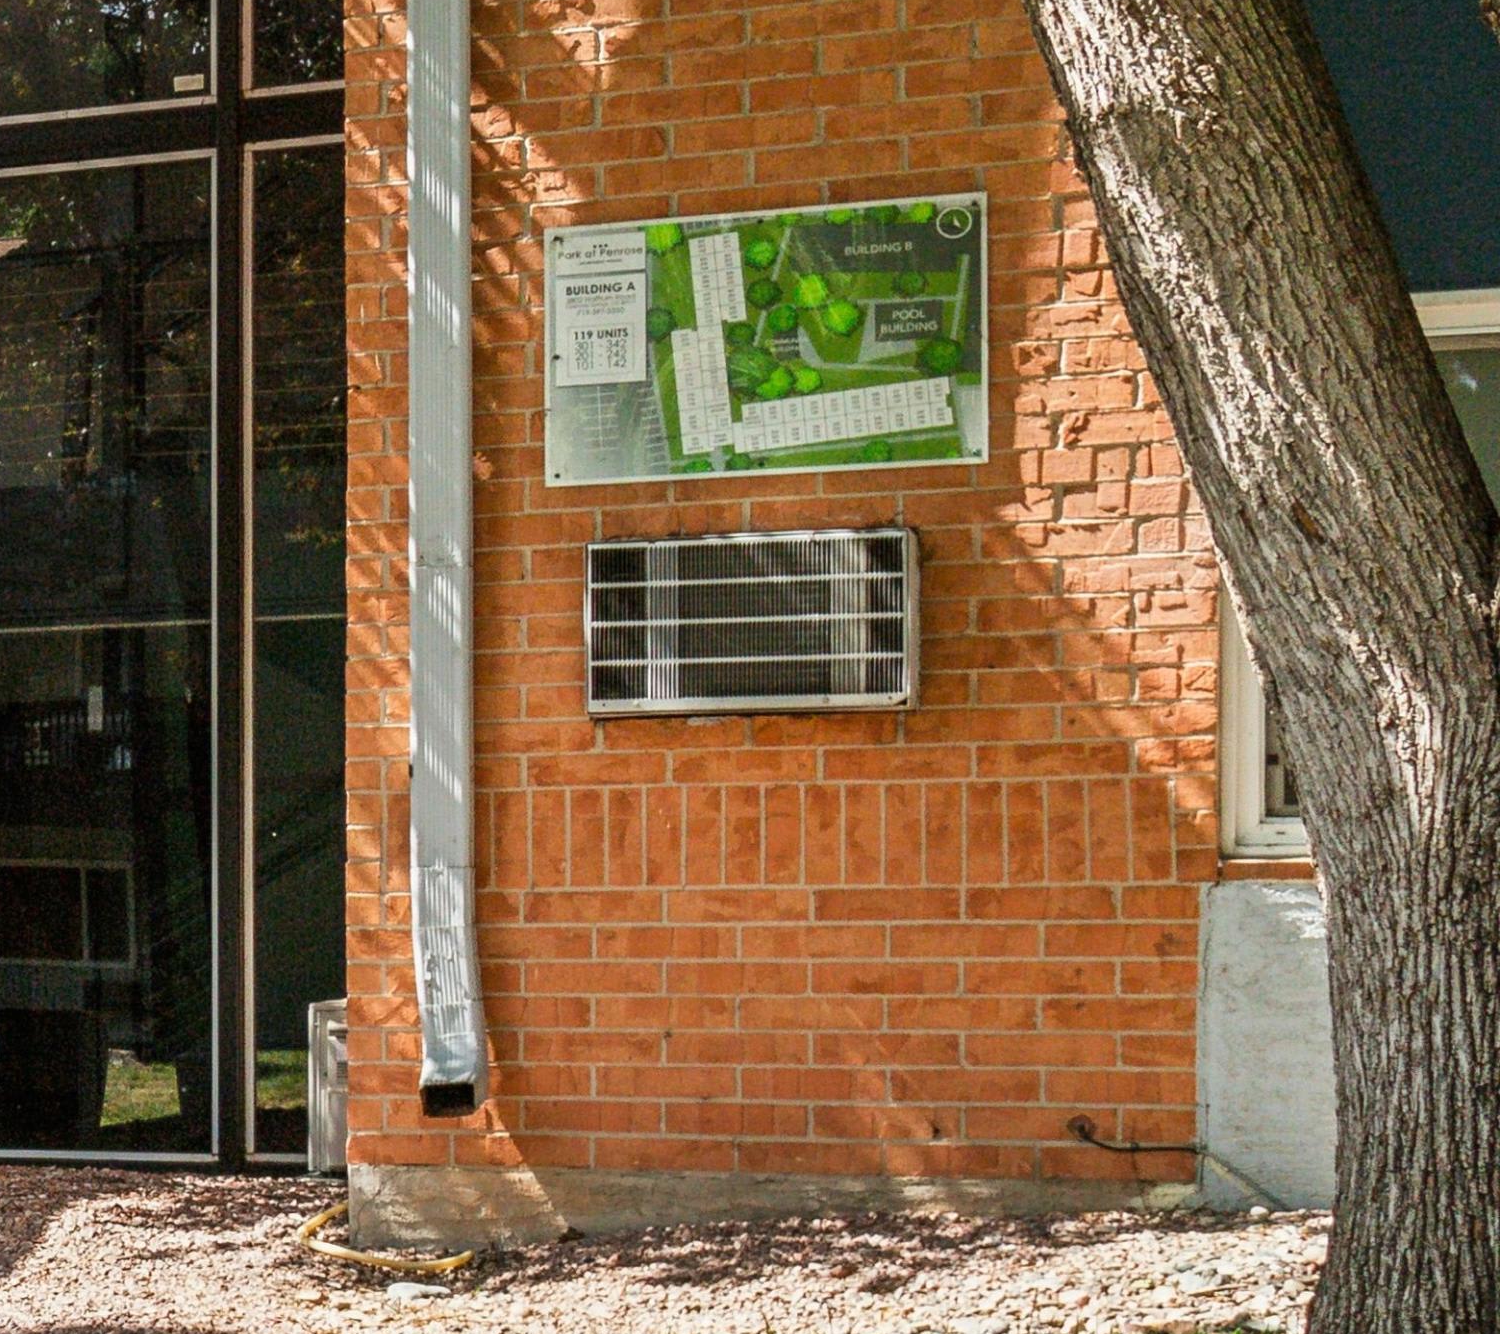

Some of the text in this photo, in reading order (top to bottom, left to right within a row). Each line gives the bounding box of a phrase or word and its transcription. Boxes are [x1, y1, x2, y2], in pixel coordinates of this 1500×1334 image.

[558, 247, 643, 259] Park at Penrose
[844, 241, 913, 256] BUILDING B
[566, 281, 636, 296] BUILDING A
[892, 309, 926, 320] POOL
[574, 327, 629, 340] 119 UNITS
[880, 321, 938, 334] BUILDING
